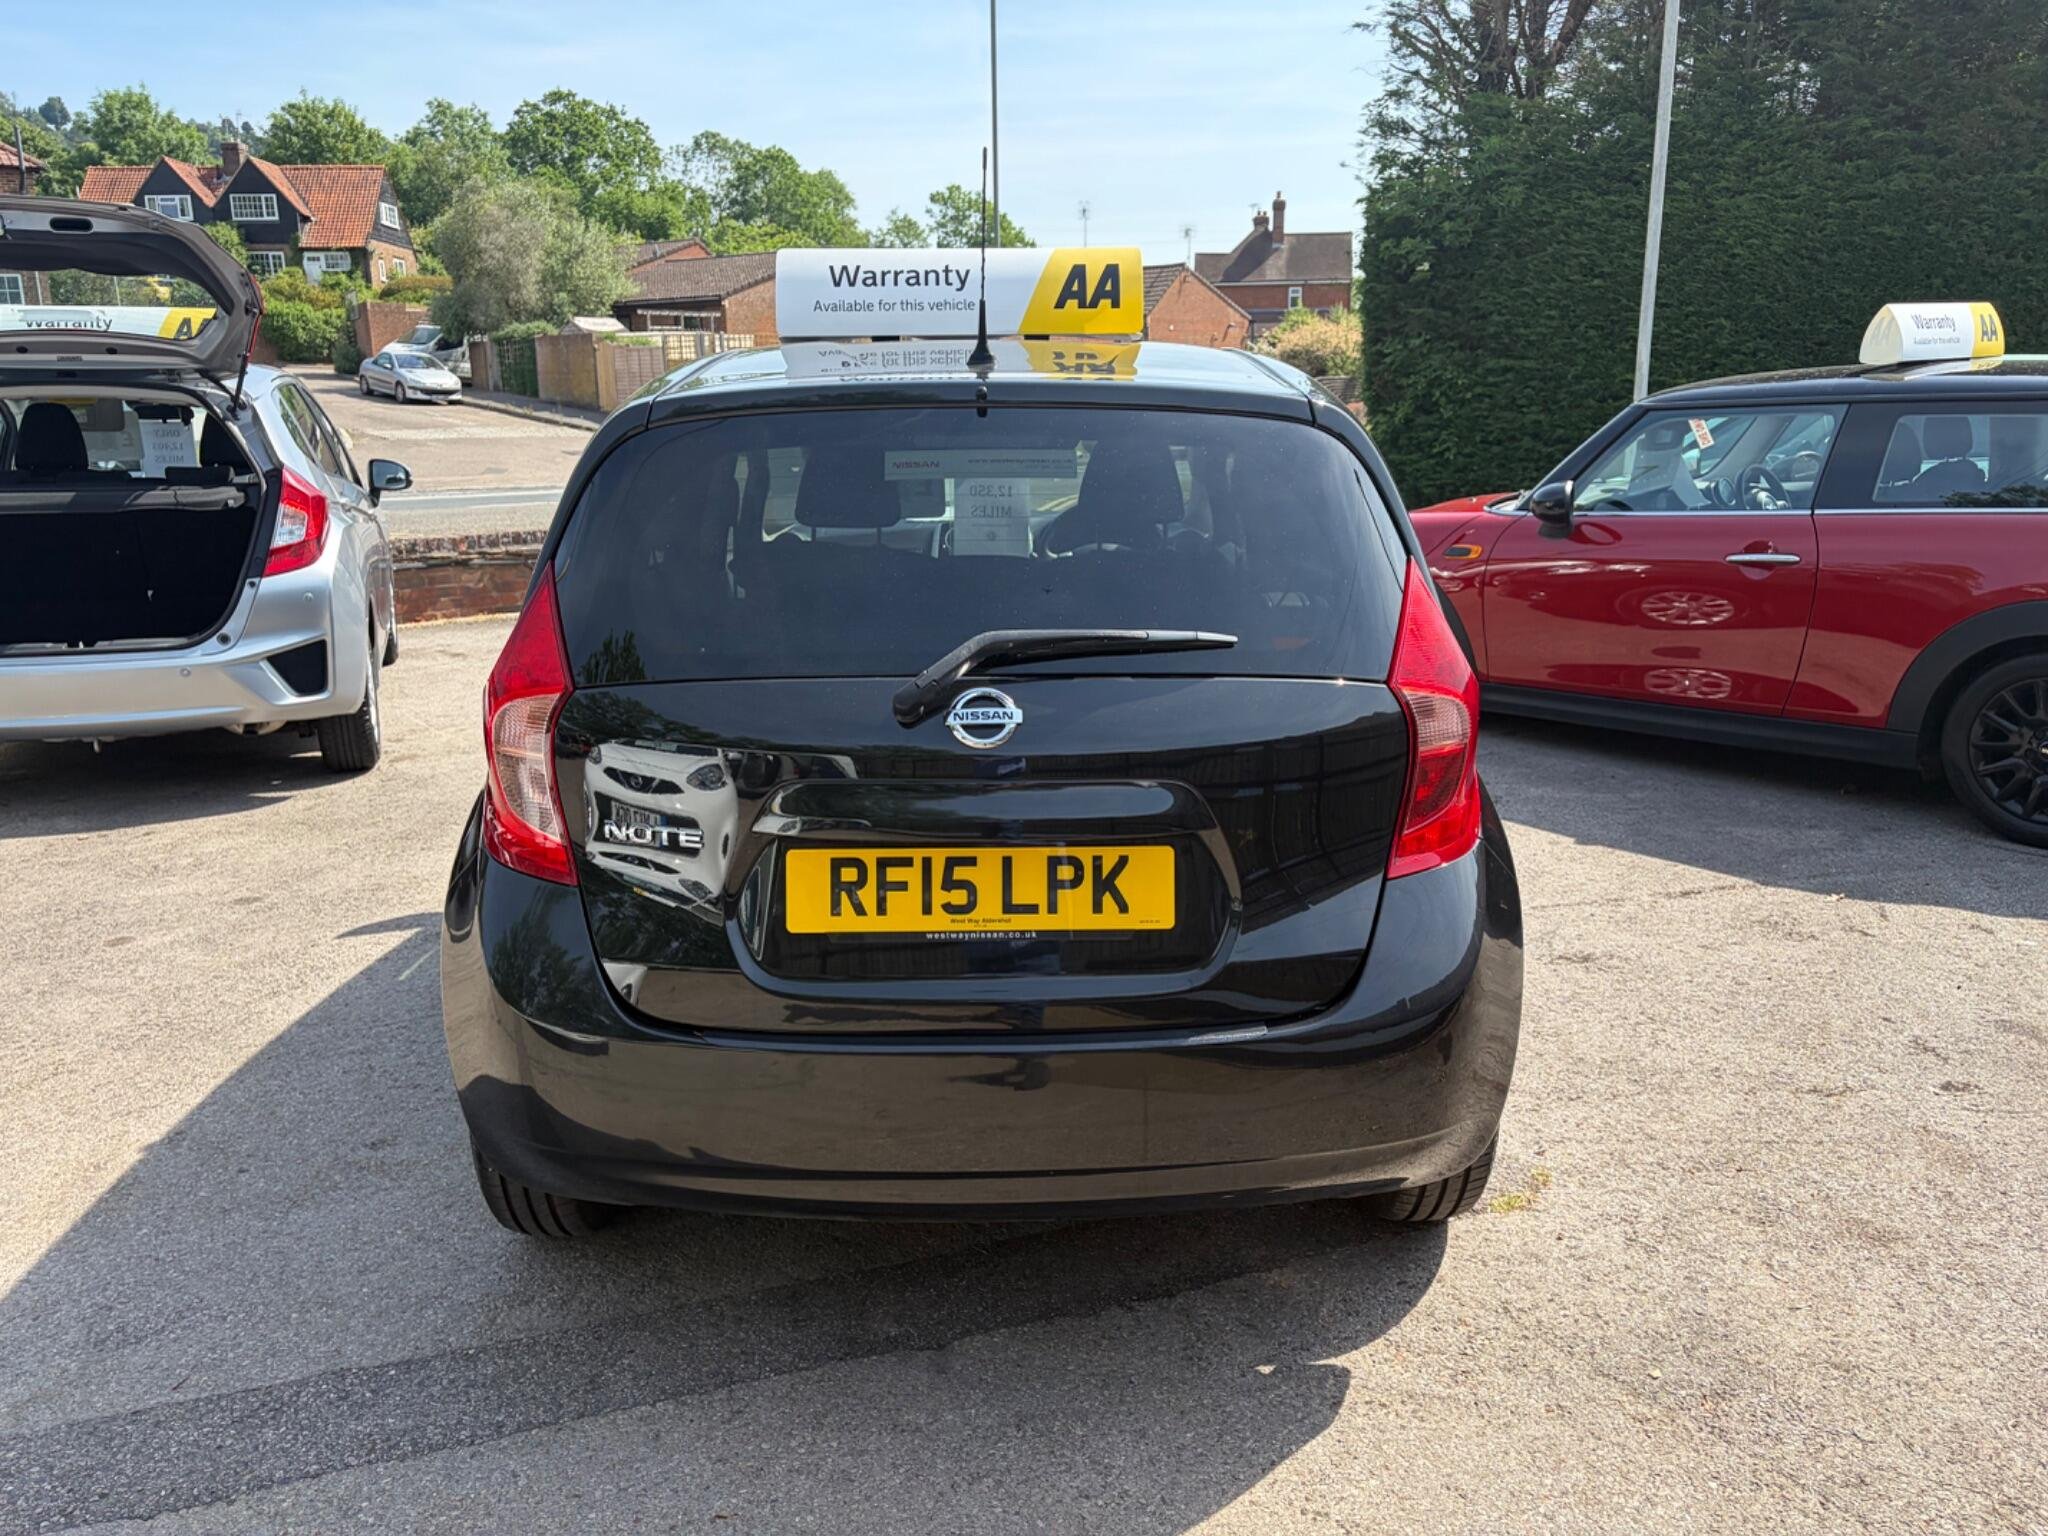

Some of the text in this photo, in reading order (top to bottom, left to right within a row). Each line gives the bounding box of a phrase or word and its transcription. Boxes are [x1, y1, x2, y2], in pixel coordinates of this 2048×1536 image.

[829, 263, 971, 291] Warranty
[1053, 263, 1121, 309] AA
[813, 298, 976, 313] Available for this vehicle
[1911, 313, 1957, 333] Warranty
[1979, 314, 1999, 342] AA
[953, 711, 1013, 722] NISSAN
[604, 820, 705, 849] NOTE
[830, 854, 1130, 916] RF15 LPK
[925, 931, 1037, 941] westwaynissan.co.uk
